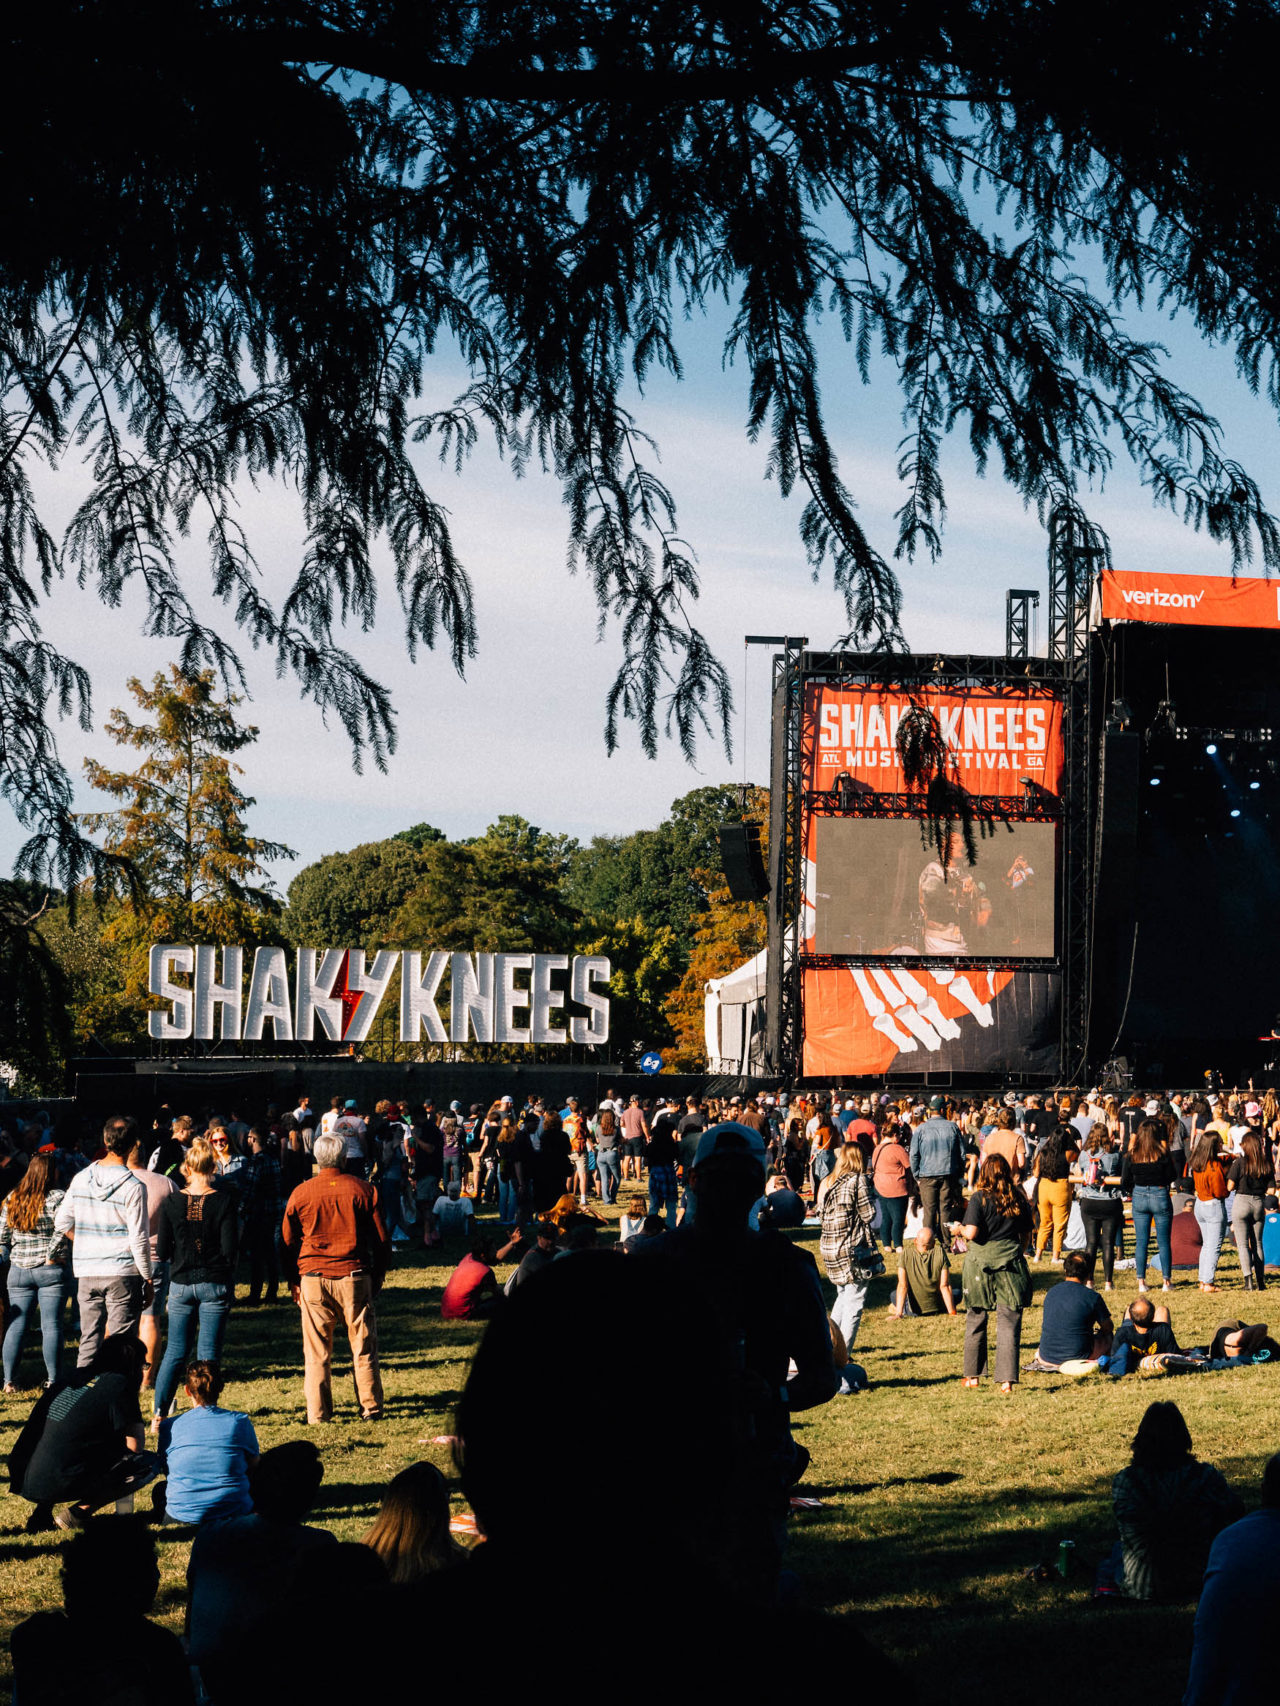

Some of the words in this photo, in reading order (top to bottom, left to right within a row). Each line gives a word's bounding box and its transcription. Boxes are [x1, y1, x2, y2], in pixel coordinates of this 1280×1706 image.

[1122, 588, 1196, 608] verizon
[939, 705, 1046, 751] KNEES
[822, 752, 840, 764] ATL
[846, 750, 912, 769] MUSI
[1027, 756, 1043, 767] GA
[148, 944, 399, 1042] SHAKY
[400, 949, 611, 1044] KNEES
